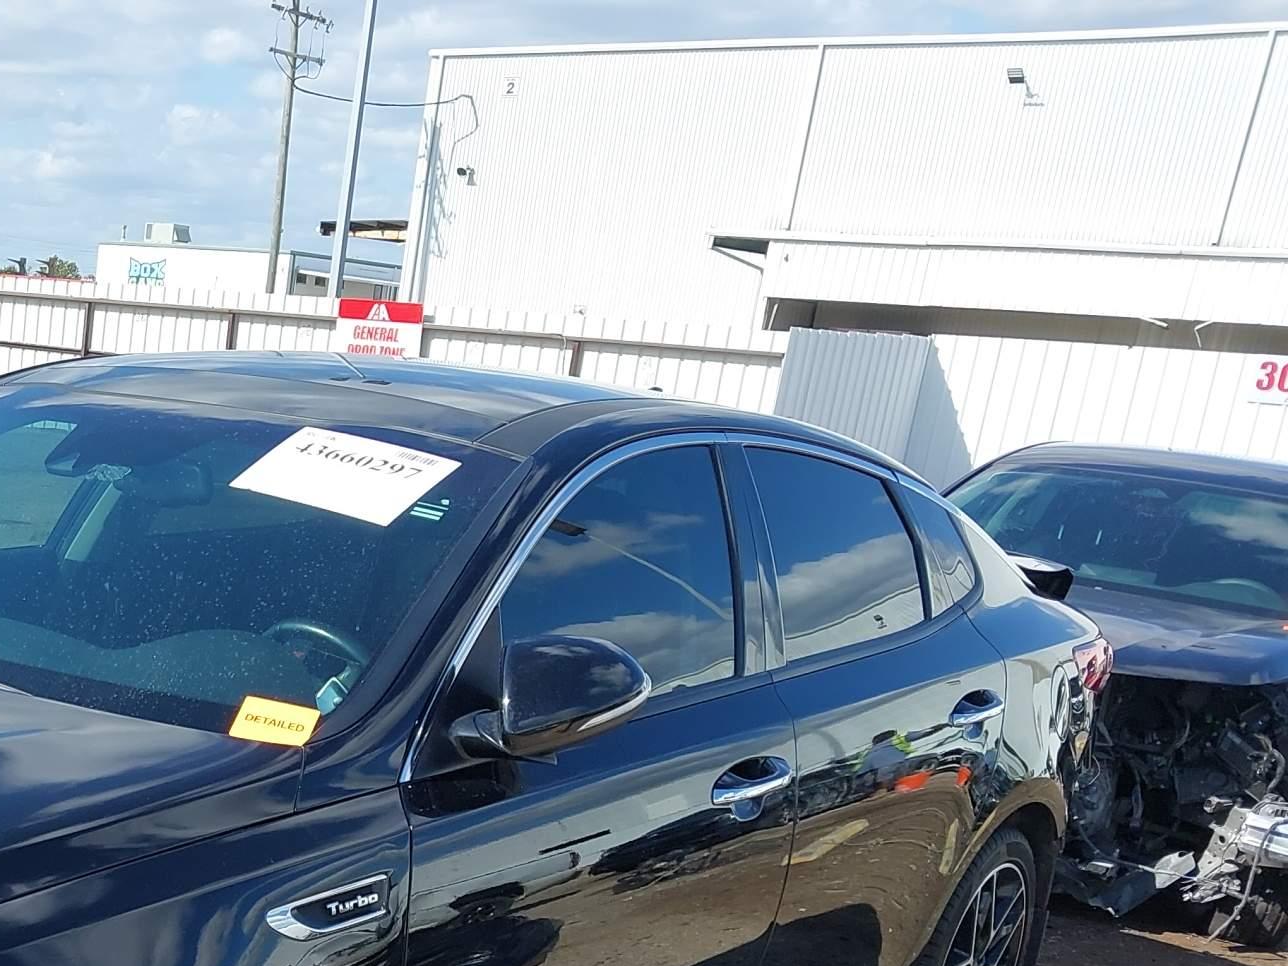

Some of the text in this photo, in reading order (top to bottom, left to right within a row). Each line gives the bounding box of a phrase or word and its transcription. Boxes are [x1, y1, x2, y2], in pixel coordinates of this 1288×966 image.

[506, 82, 515, 94] 2
[129, 257, 167, 279] BOX
[353, 325, 400, 343] GENERAL
[296, 442, 424, 479] 43660297
[244, 712, 305, 733] DETAILED
[326, 893, 379, 916] Turbo
